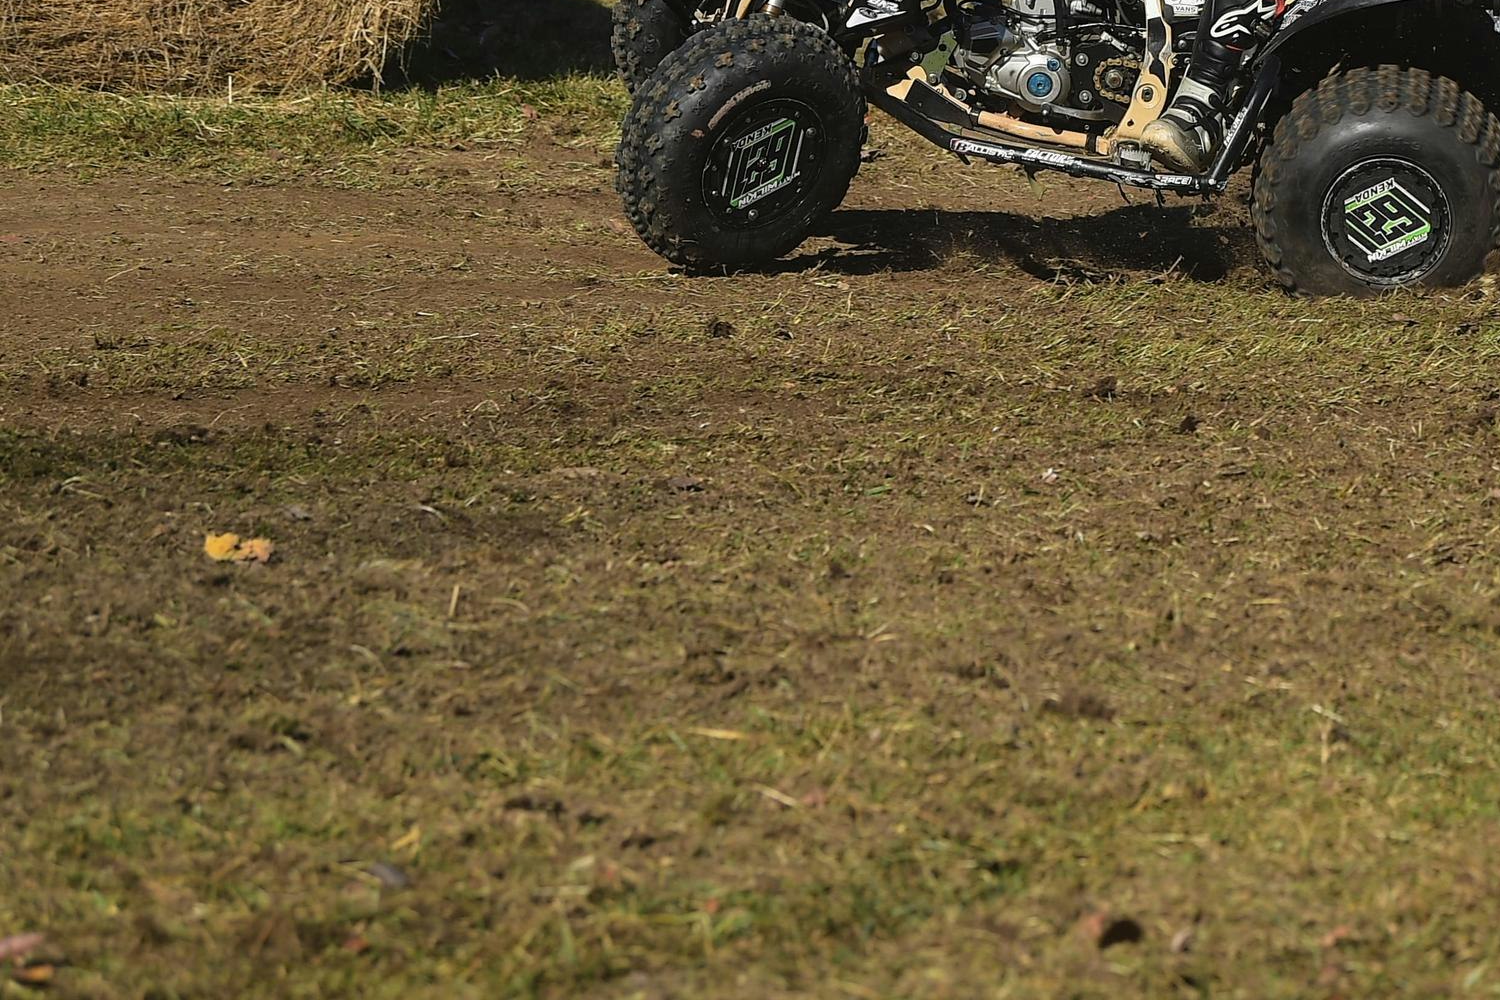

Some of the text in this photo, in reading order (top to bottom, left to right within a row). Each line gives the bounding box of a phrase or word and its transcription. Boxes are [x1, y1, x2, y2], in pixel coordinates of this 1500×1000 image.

[731, 123, 774, 151] KENDA
[1354, 178, 1396, 203] KENDA
[1349, 194, 1426, 246] 621
